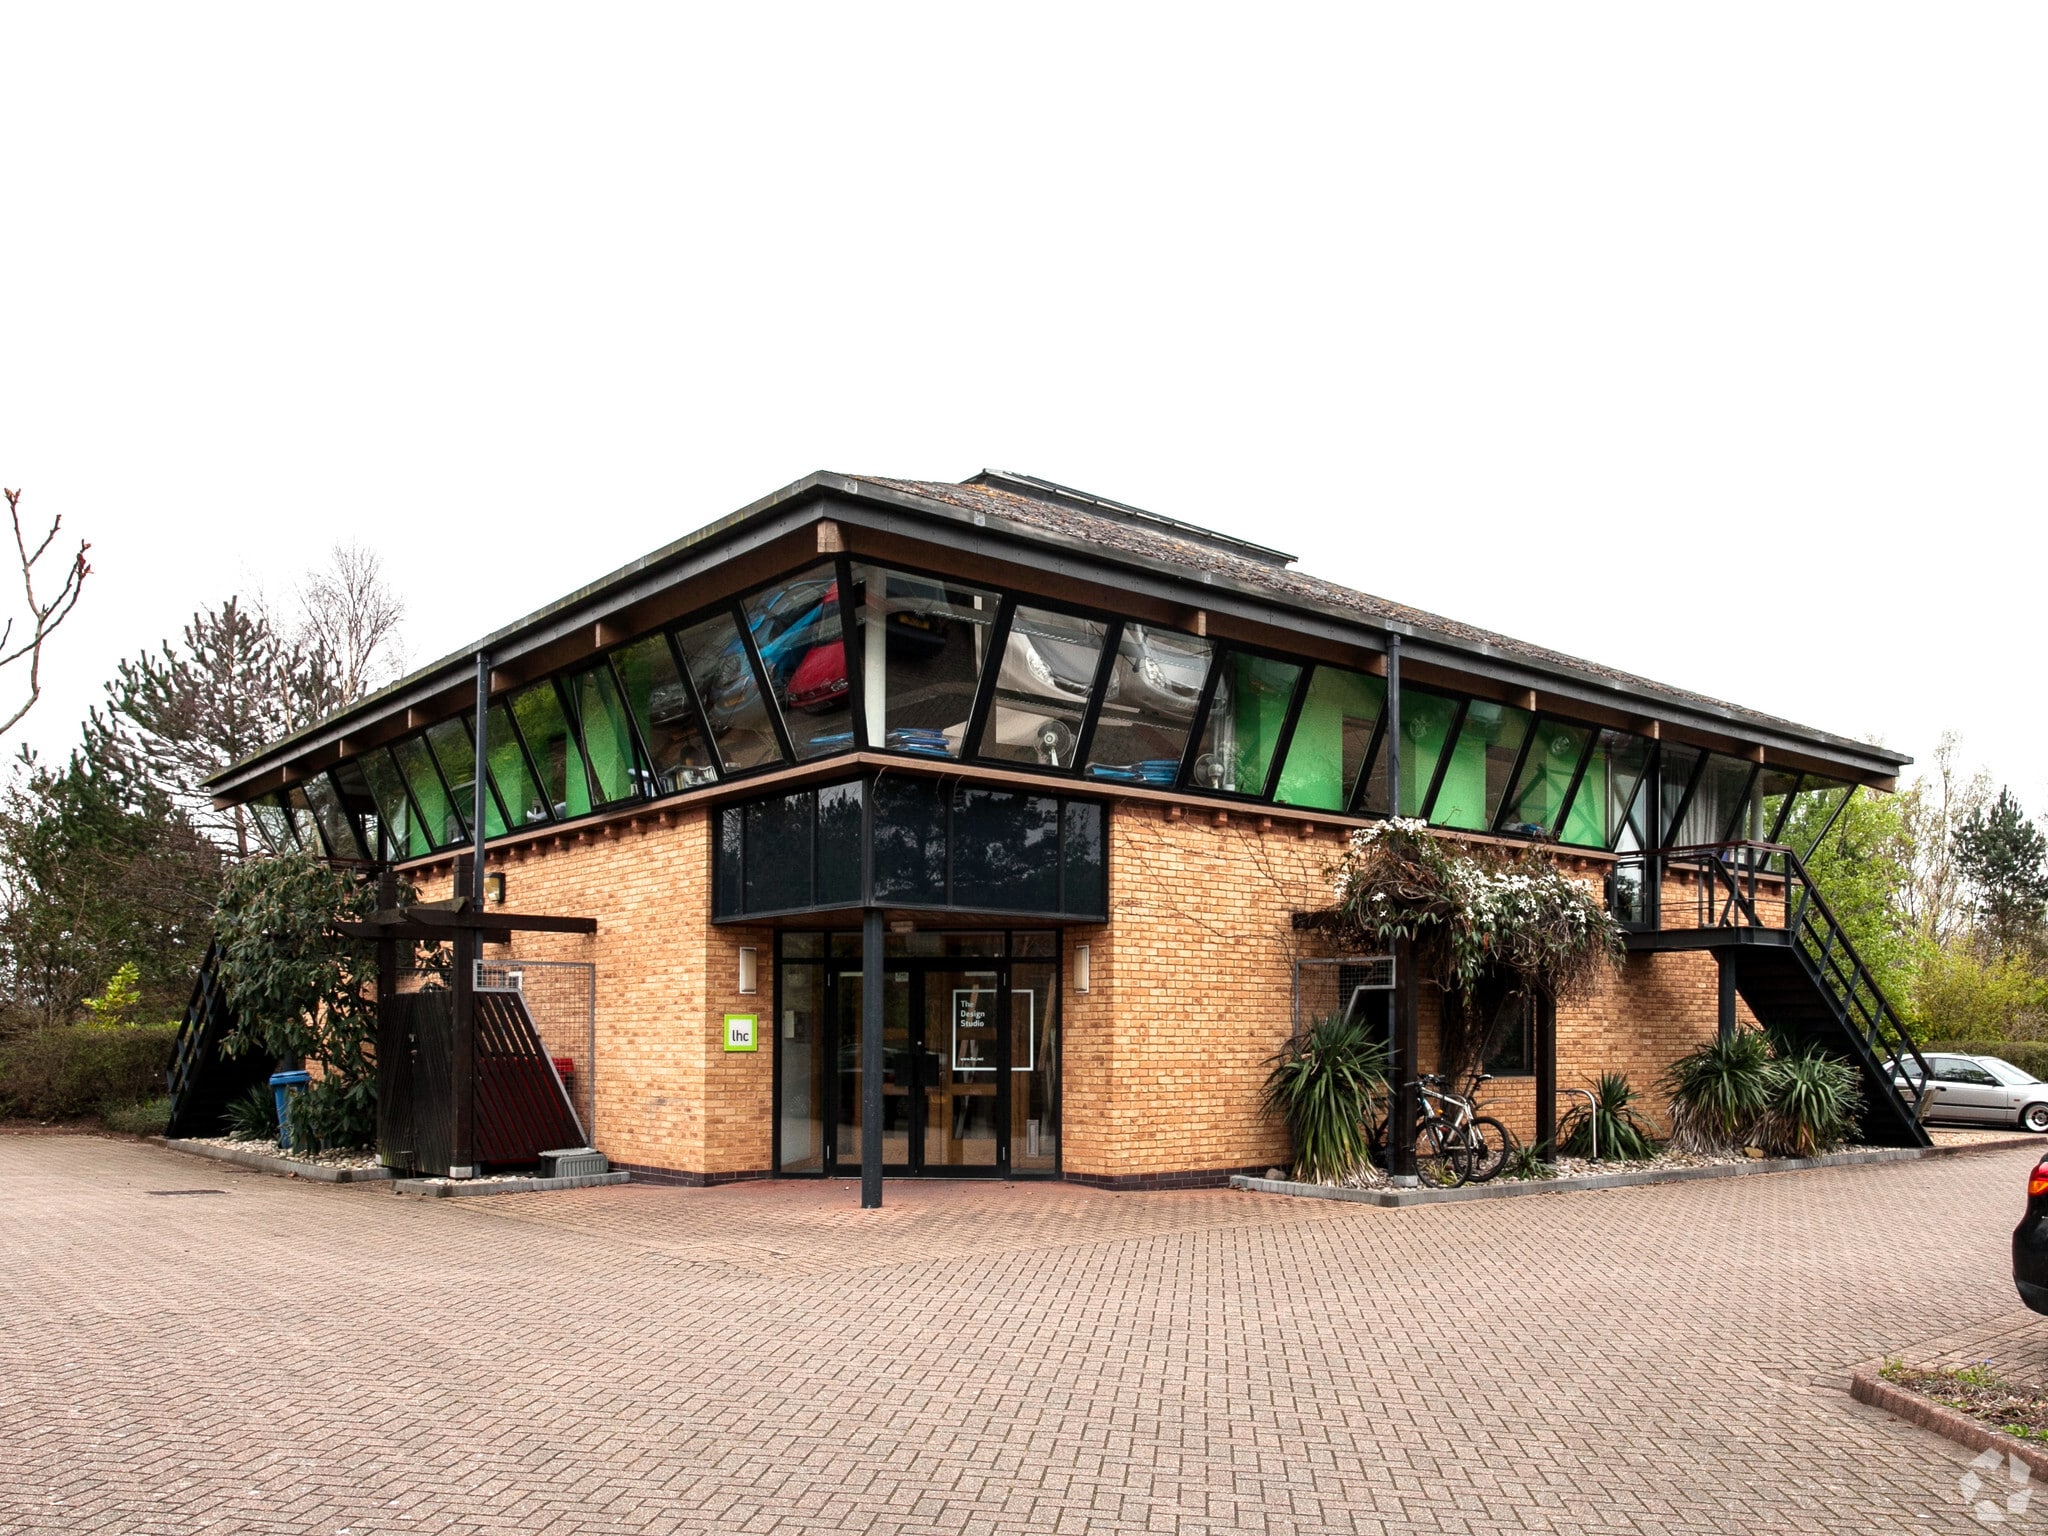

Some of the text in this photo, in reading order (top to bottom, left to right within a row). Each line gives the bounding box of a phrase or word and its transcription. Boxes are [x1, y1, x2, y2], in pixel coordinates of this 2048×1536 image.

[960, 1000, 974, 1008] The
[960, 1010, 985, 1019] Design
[732, 1029, 749, 1041] lhc
